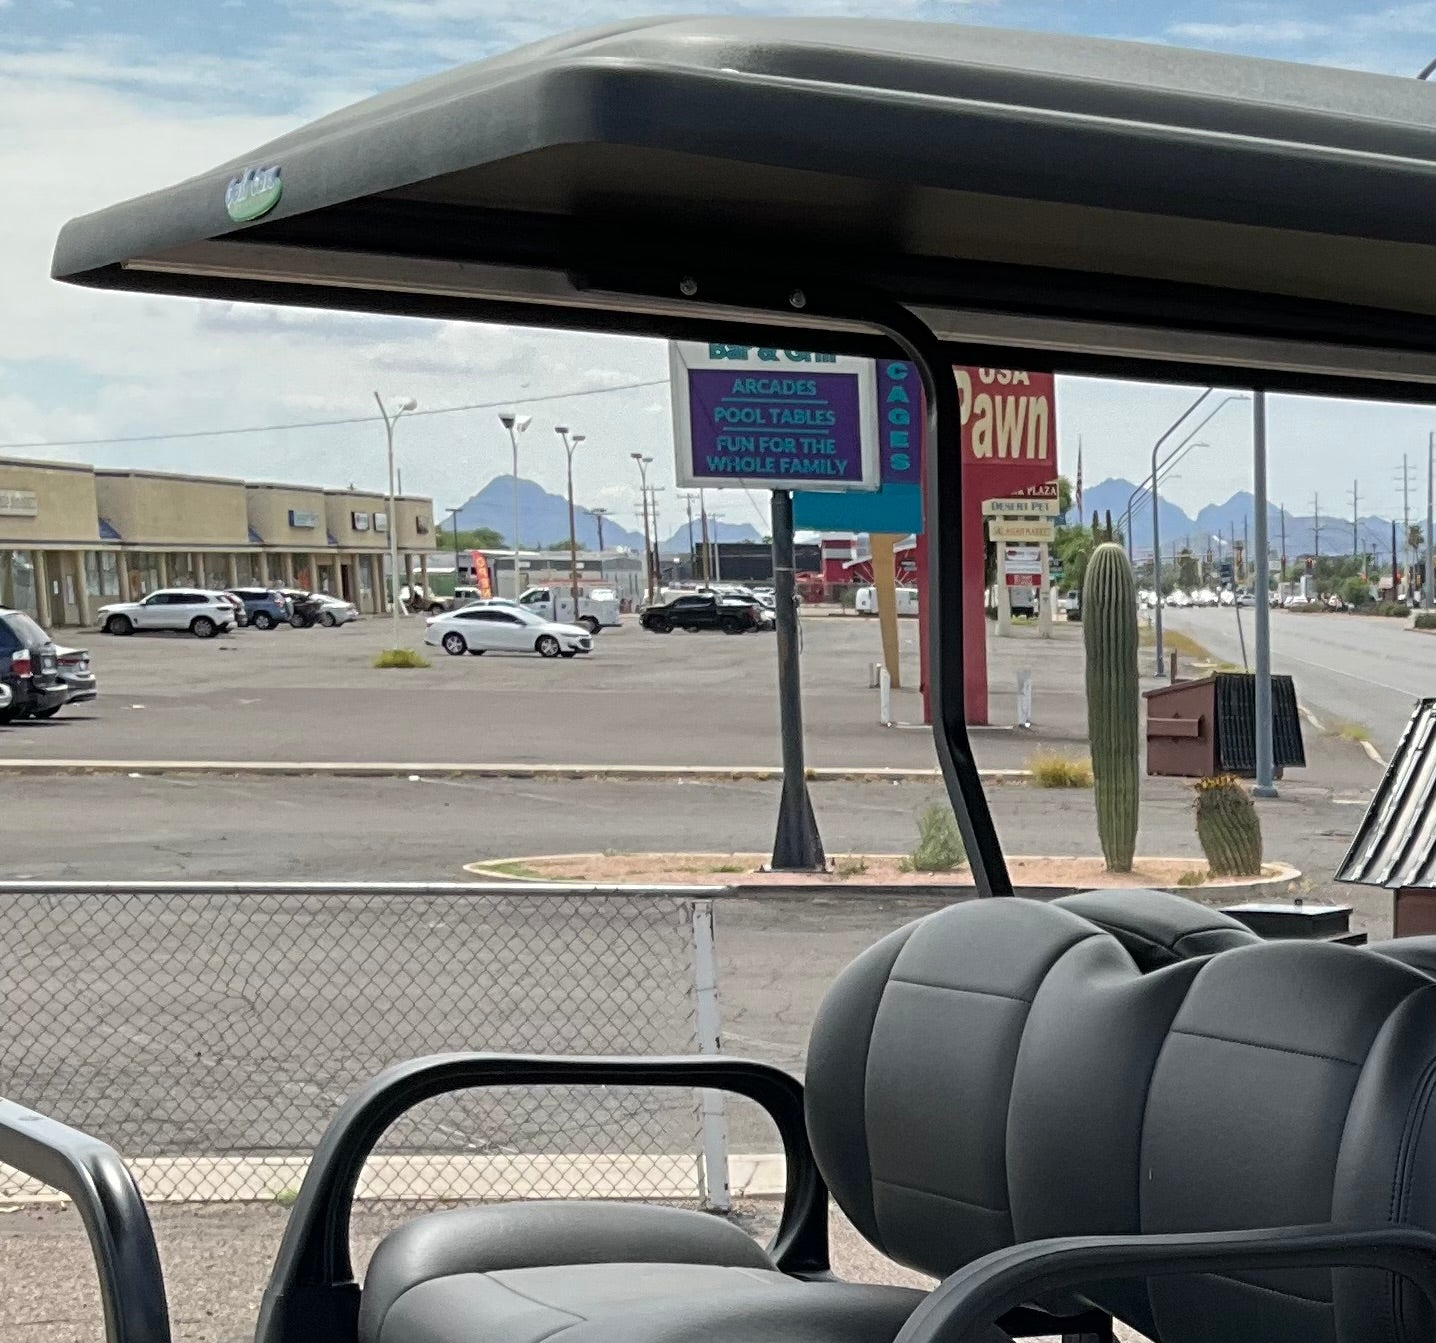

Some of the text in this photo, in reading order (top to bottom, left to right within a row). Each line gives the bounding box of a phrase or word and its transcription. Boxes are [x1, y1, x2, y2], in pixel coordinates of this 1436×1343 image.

[978, 367, 1030, 385] USA
[731, 378, 817, 396] ARCADES
[714, 407, 836, 426] POOL TABLES
[886, 362, 911, 471] CAGES
[716, 436, 836, 455] FUN FOR THE
[706, 455, 848, 475] WHOLE FAMILY
[1027, 485, 1057, 496] PLAZA
[991, 502, 1028, 511] DESERT
